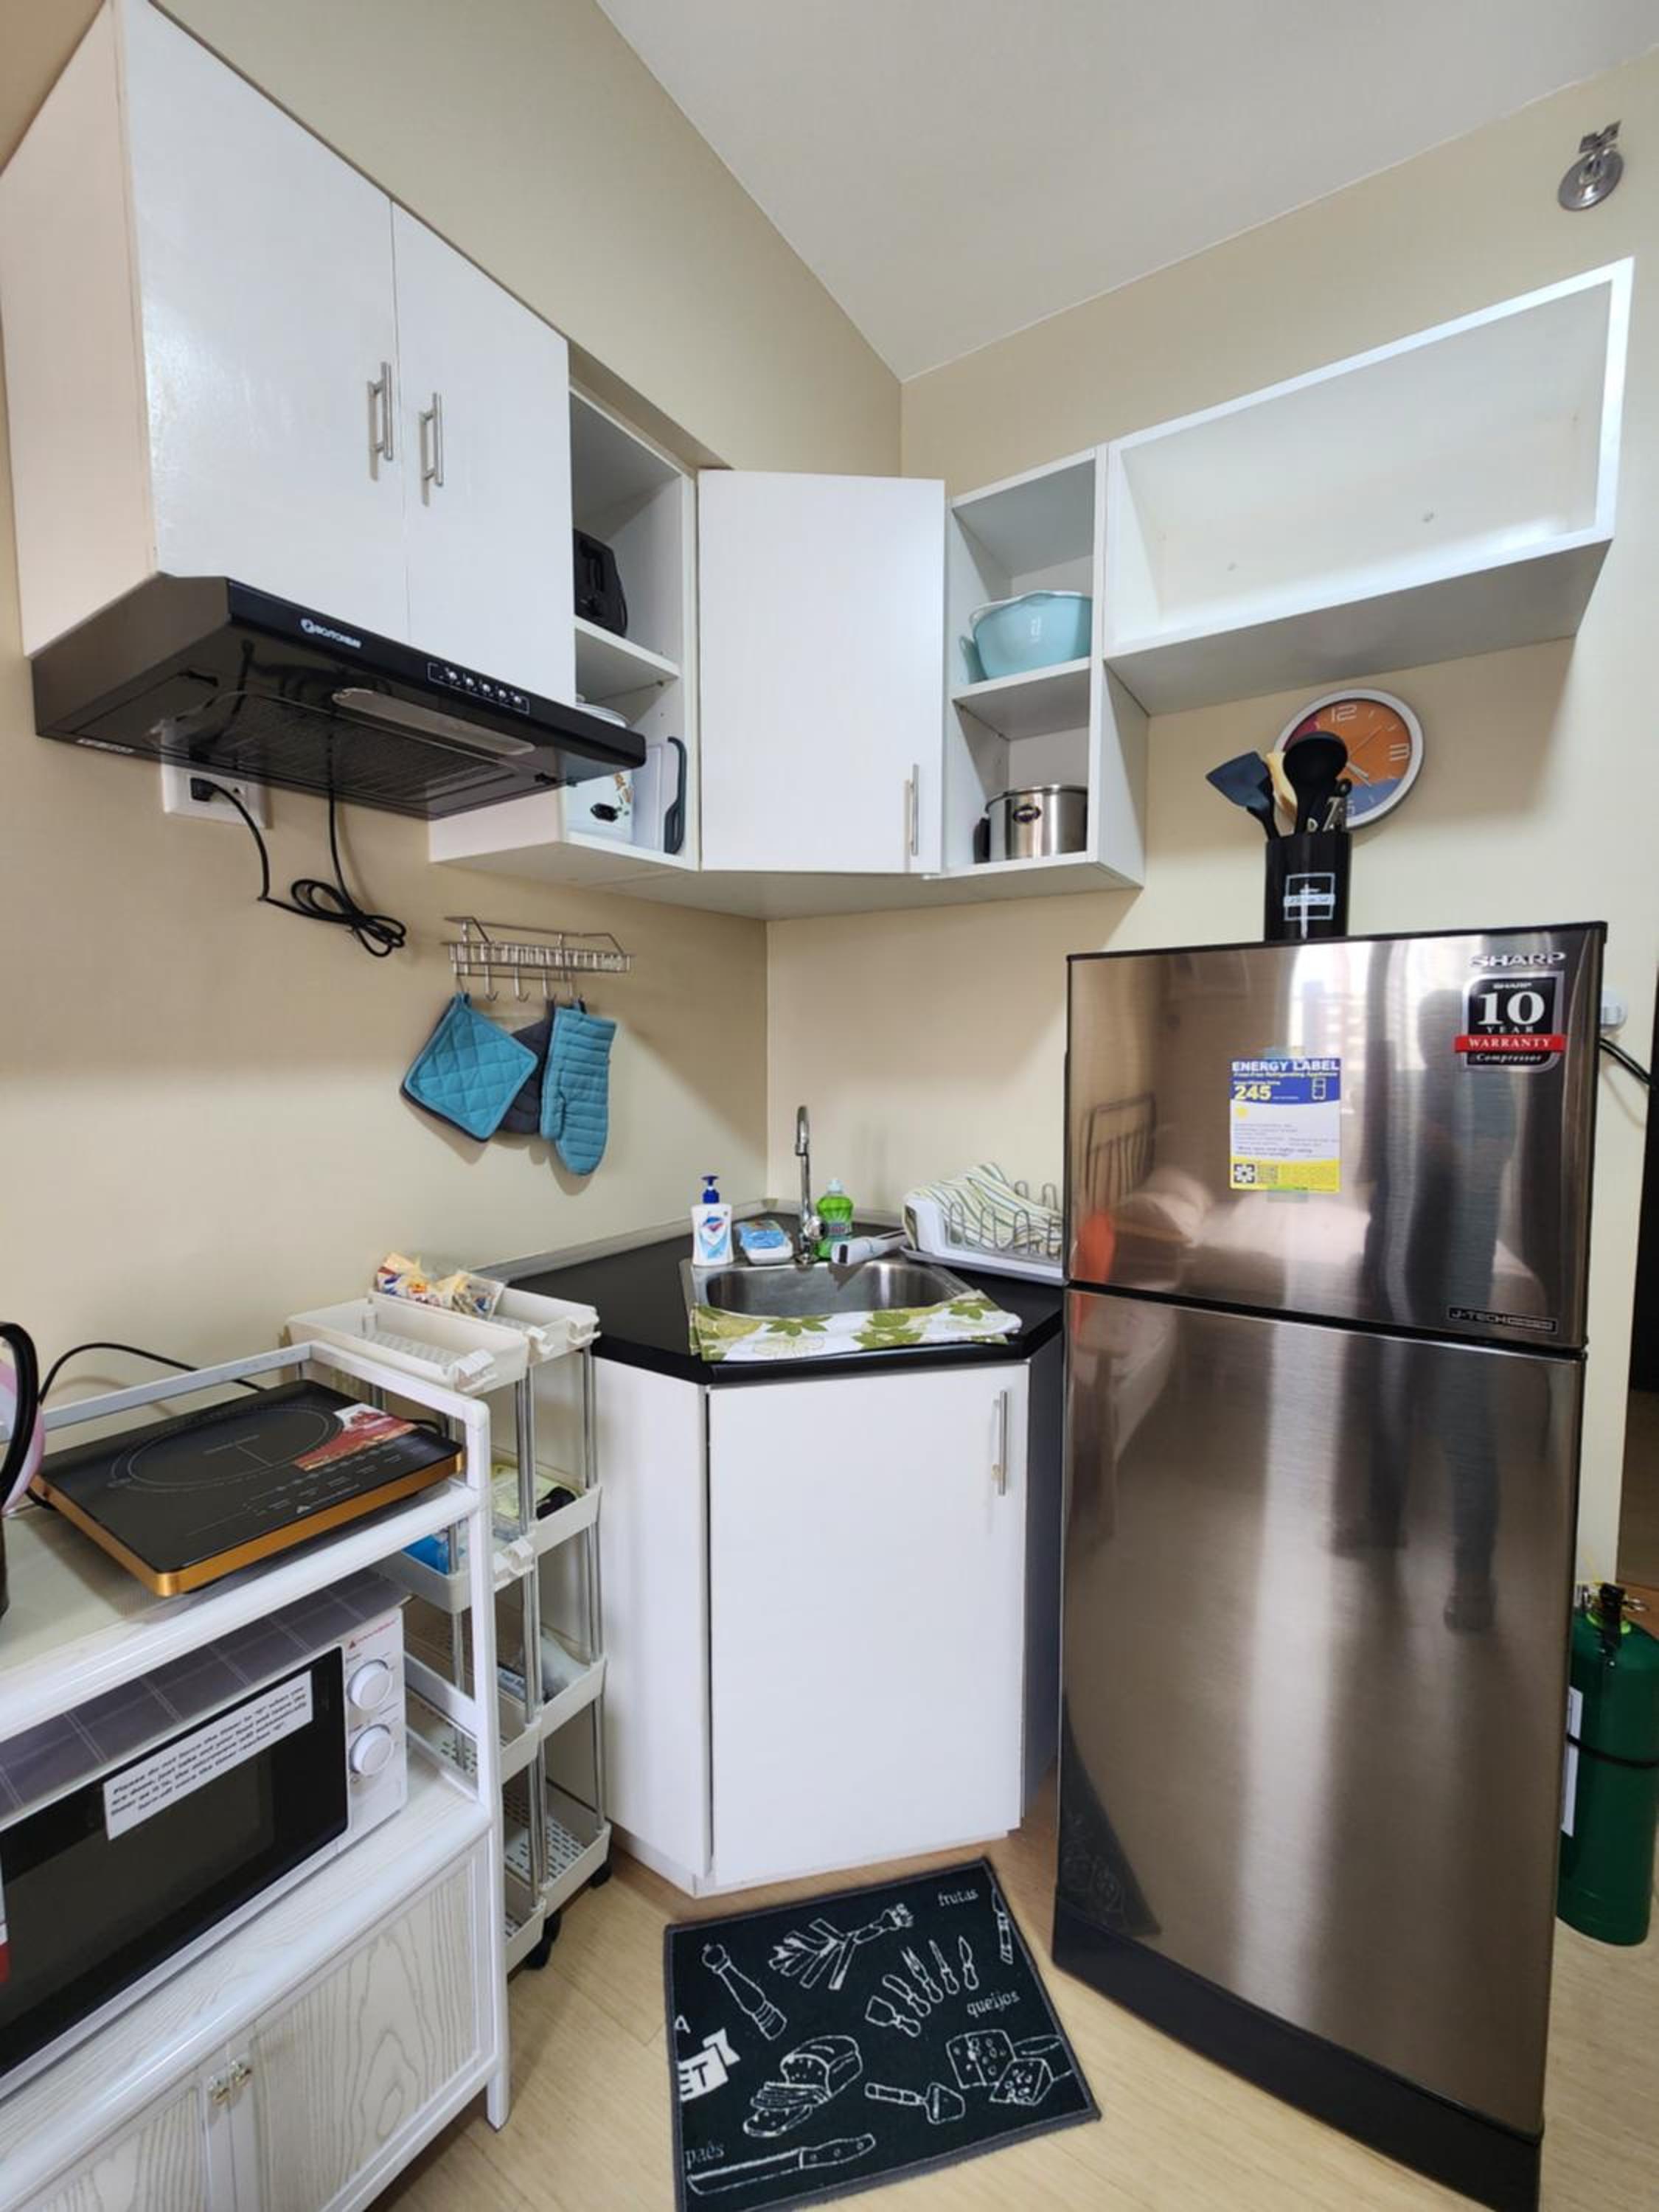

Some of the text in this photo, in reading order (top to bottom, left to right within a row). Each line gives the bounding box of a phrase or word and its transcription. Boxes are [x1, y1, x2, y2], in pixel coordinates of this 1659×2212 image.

[1469, 952, 1566, 967] SHARP
[1478, 991, 1545, 1025] 10
[1486, 1026, 1534, 1034] YEAR
[1468, 1037, 1552, 1048] WARRANTY
[1232, 1060, 1340, 1071] ENERGY LABEL
[1476, 1054, 1543, 1063] Compressor
[1234, 1085, 1271, 1100] 245
[938, 1889, 979, 1906] frutas
[967, 1992, 1020, 2018] queijos
